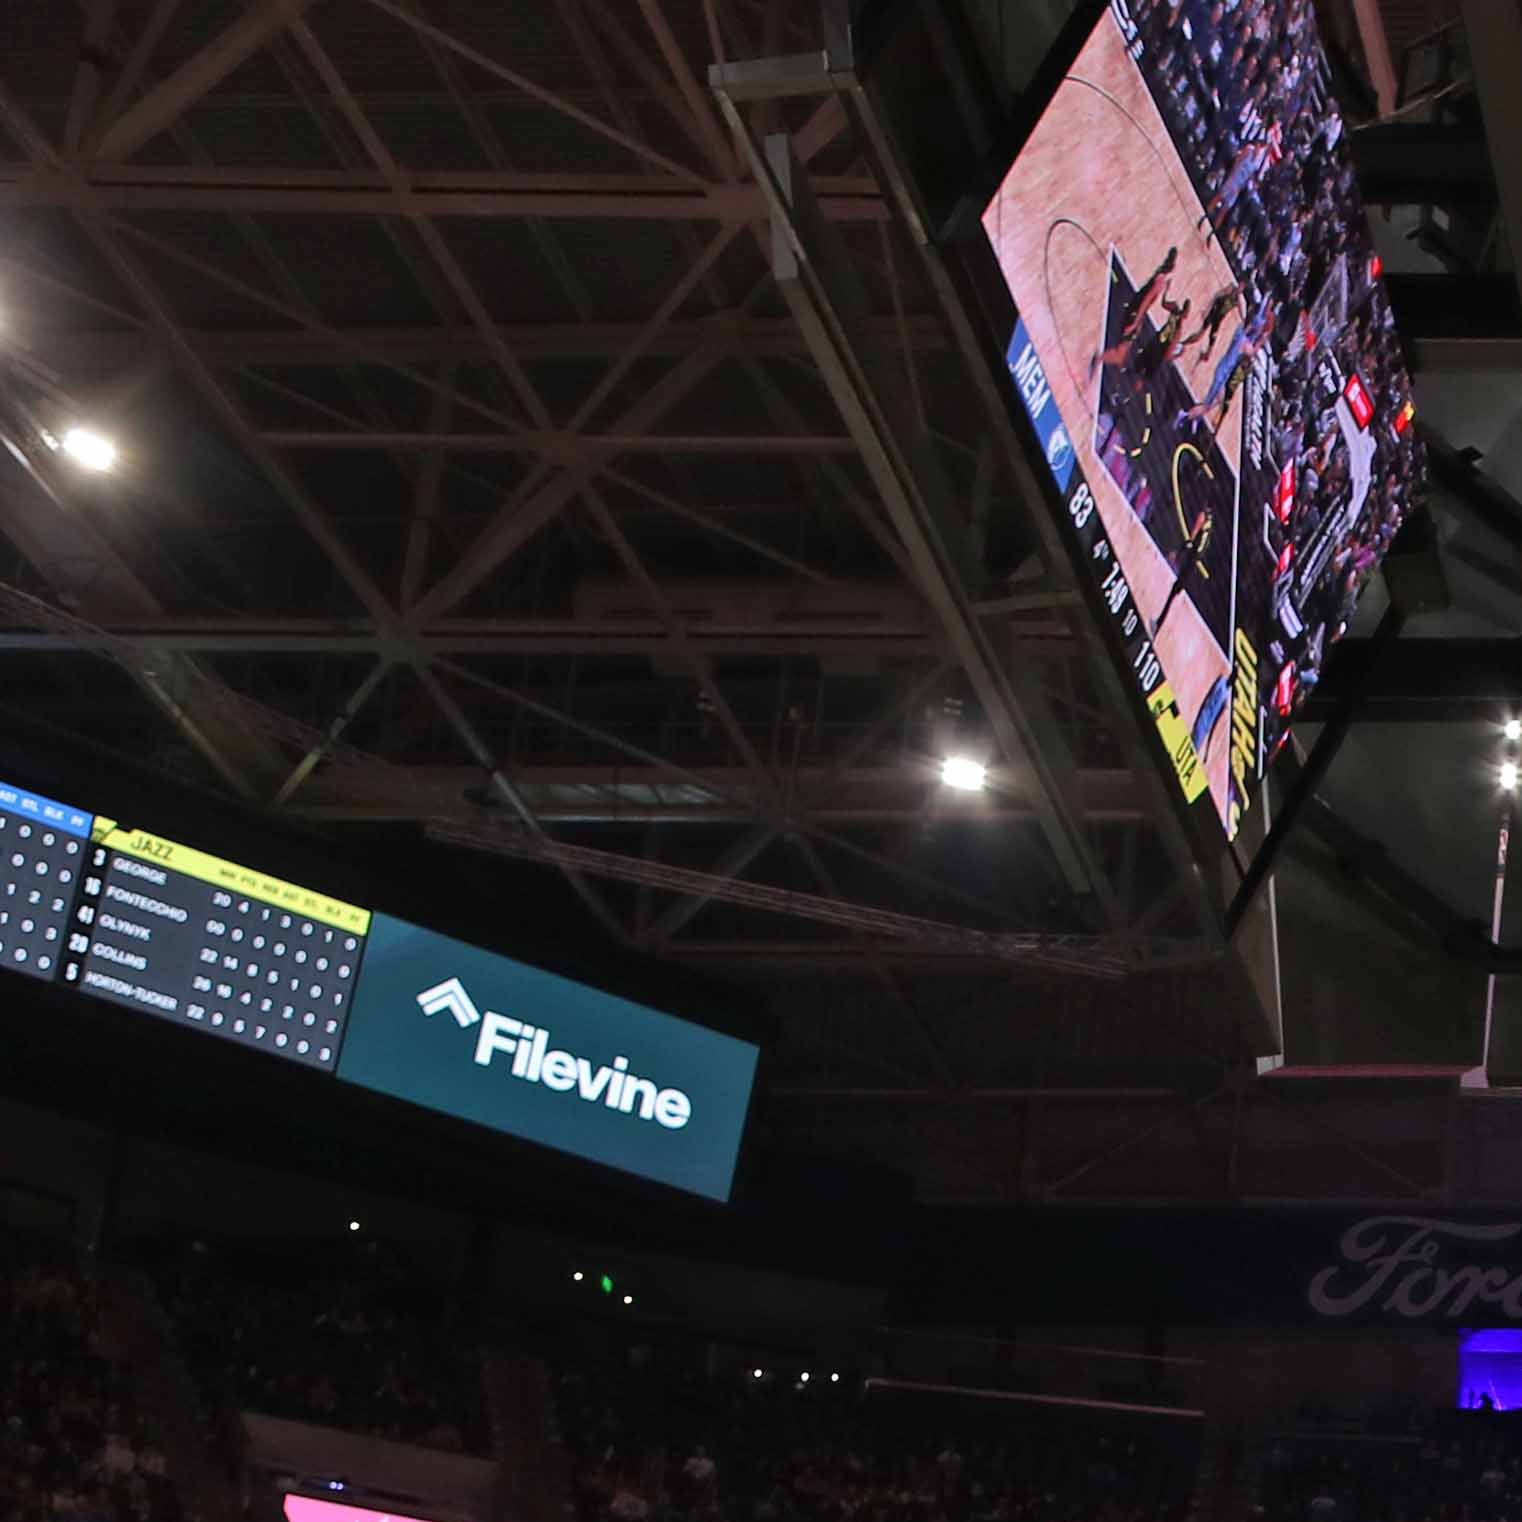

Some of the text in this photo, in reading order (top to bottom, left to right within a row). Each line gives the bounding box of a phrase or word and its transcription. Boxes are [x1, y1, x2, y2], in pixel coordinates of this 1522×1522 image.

[1014, 343, 1051, 419] MEM
[1069, 483, 1094, 529] 83
[1133, 640, 1161, 691] 110
[1175, 734, 1196, 785] UTA
[130, 833, 175, 861] JAZZ
[474, 1010, 692, 1129] Filevine
